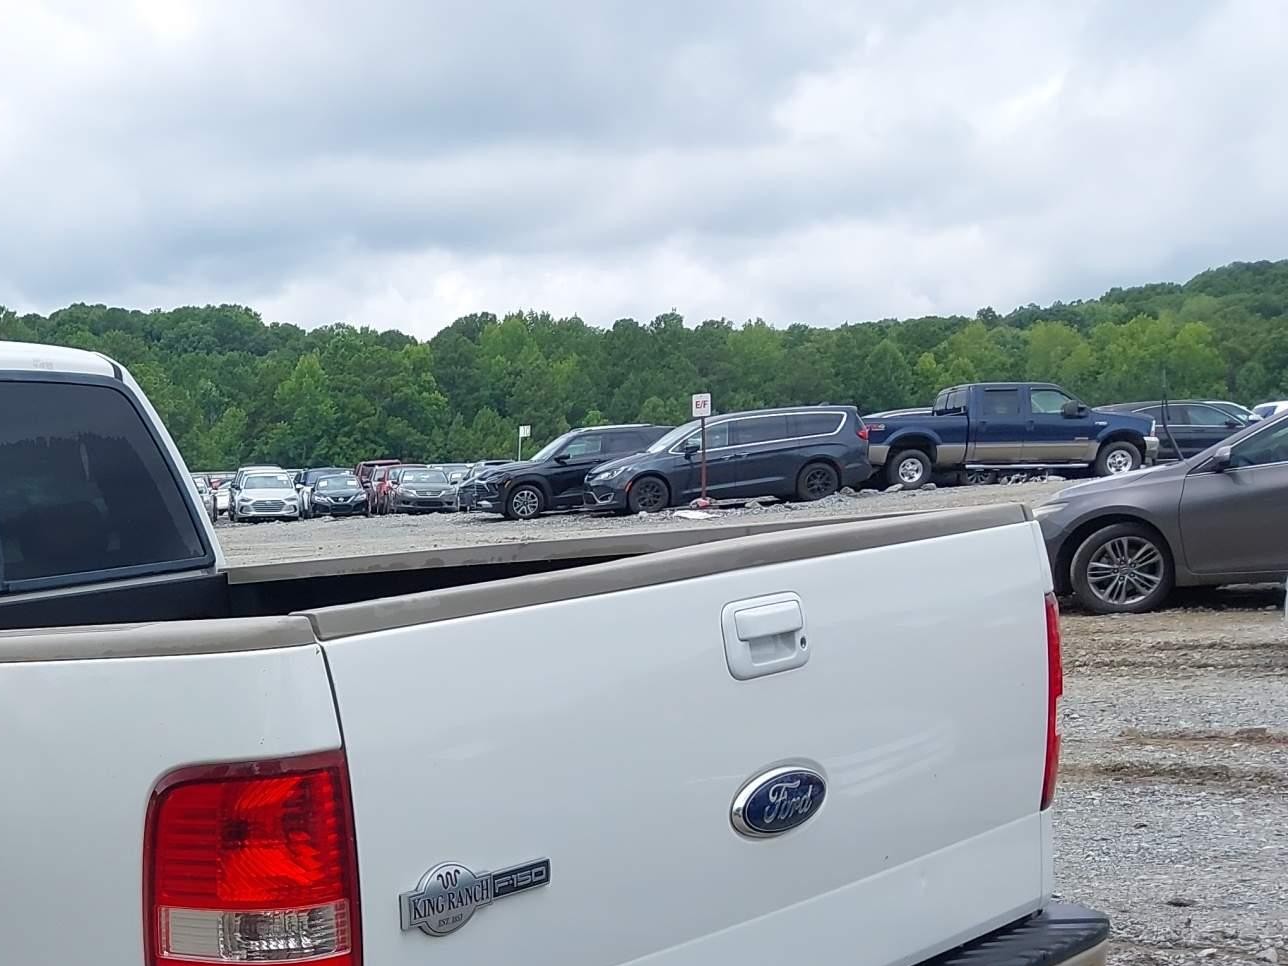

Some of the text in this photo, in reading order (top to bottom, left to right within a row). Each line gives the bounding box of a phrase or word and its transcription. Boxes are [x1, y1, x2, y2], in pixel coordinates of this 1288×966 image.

[695, 400, 709, 410] E/F
[764, 779, 813, 823] Ford
[413, 878, 489, 920] KING RANCH
